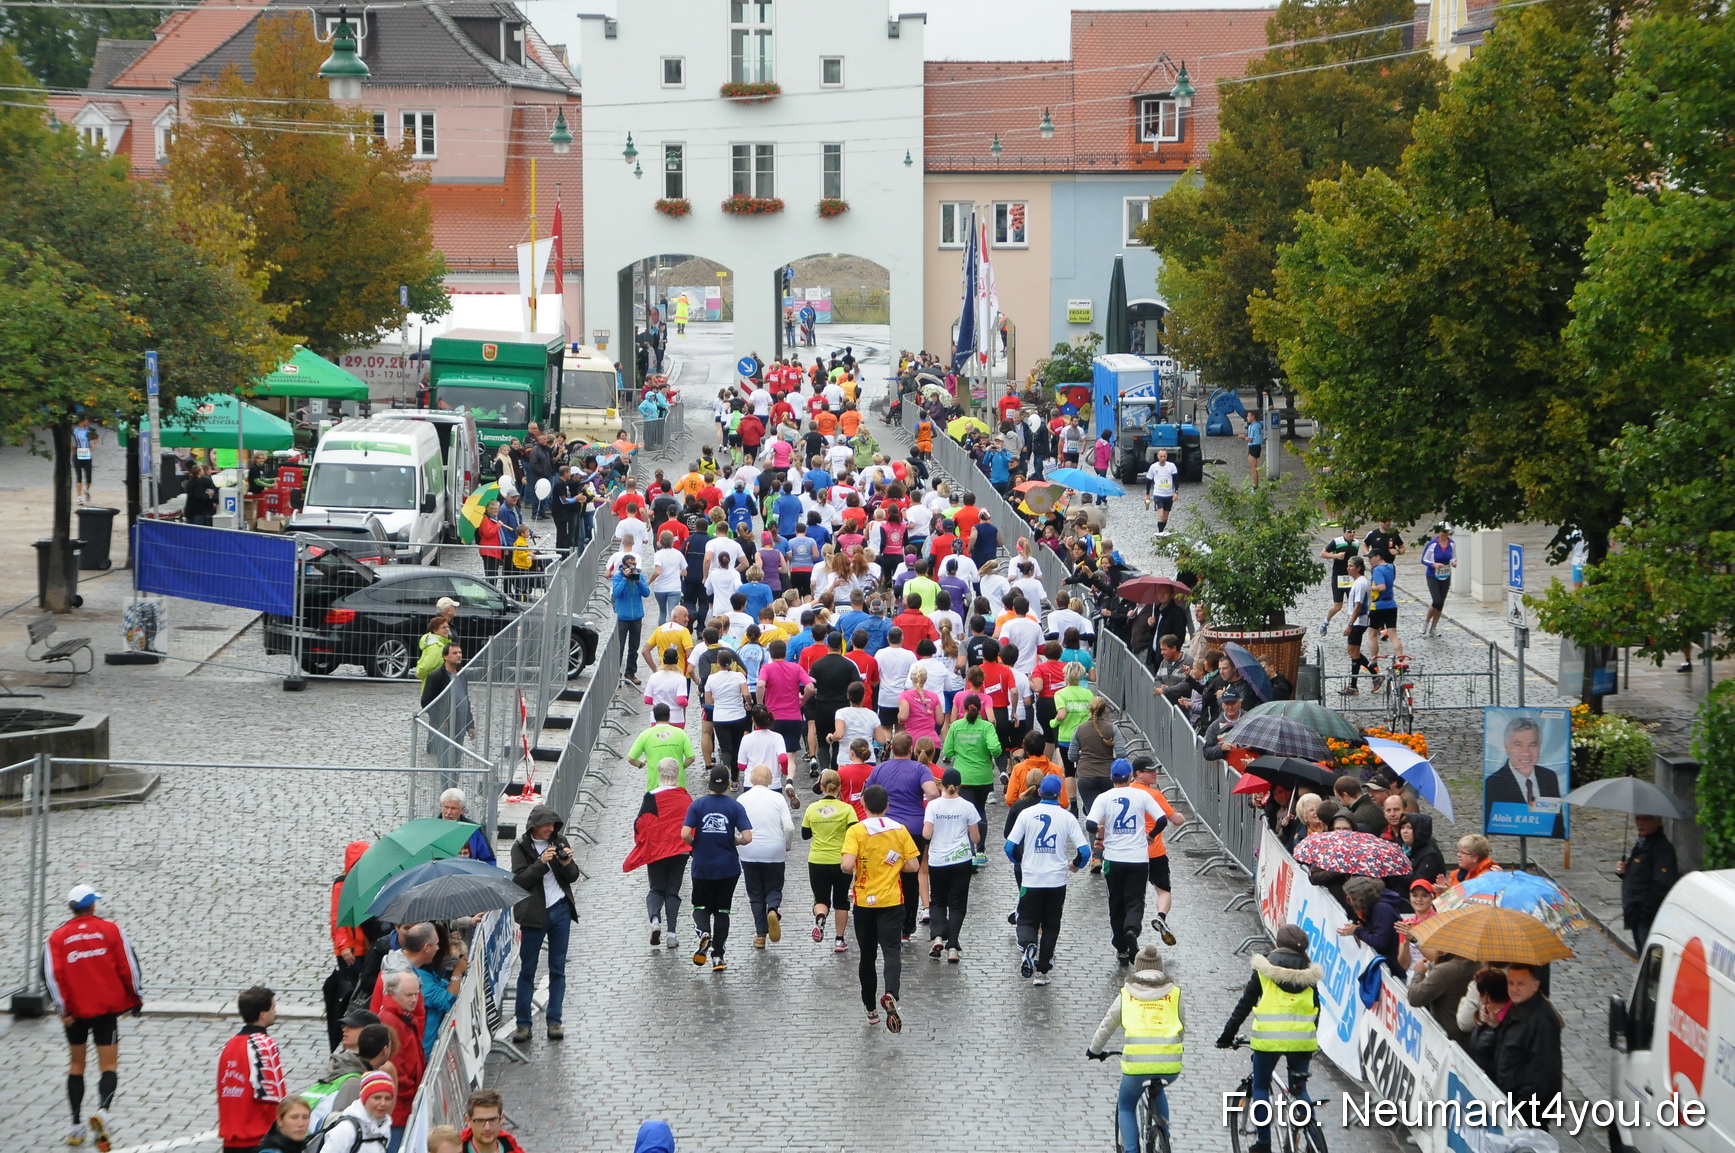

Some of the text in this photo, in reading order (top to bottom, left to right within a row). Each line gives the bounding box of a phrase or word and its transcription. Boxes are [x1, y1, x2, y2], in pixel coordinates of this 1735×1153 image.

[365, 370, 375, 378] 13
[226, 500, 234, 510] P
[1511, 550, 1520, 582] P
[1492, 813, 1540, 825] Alois KARL
